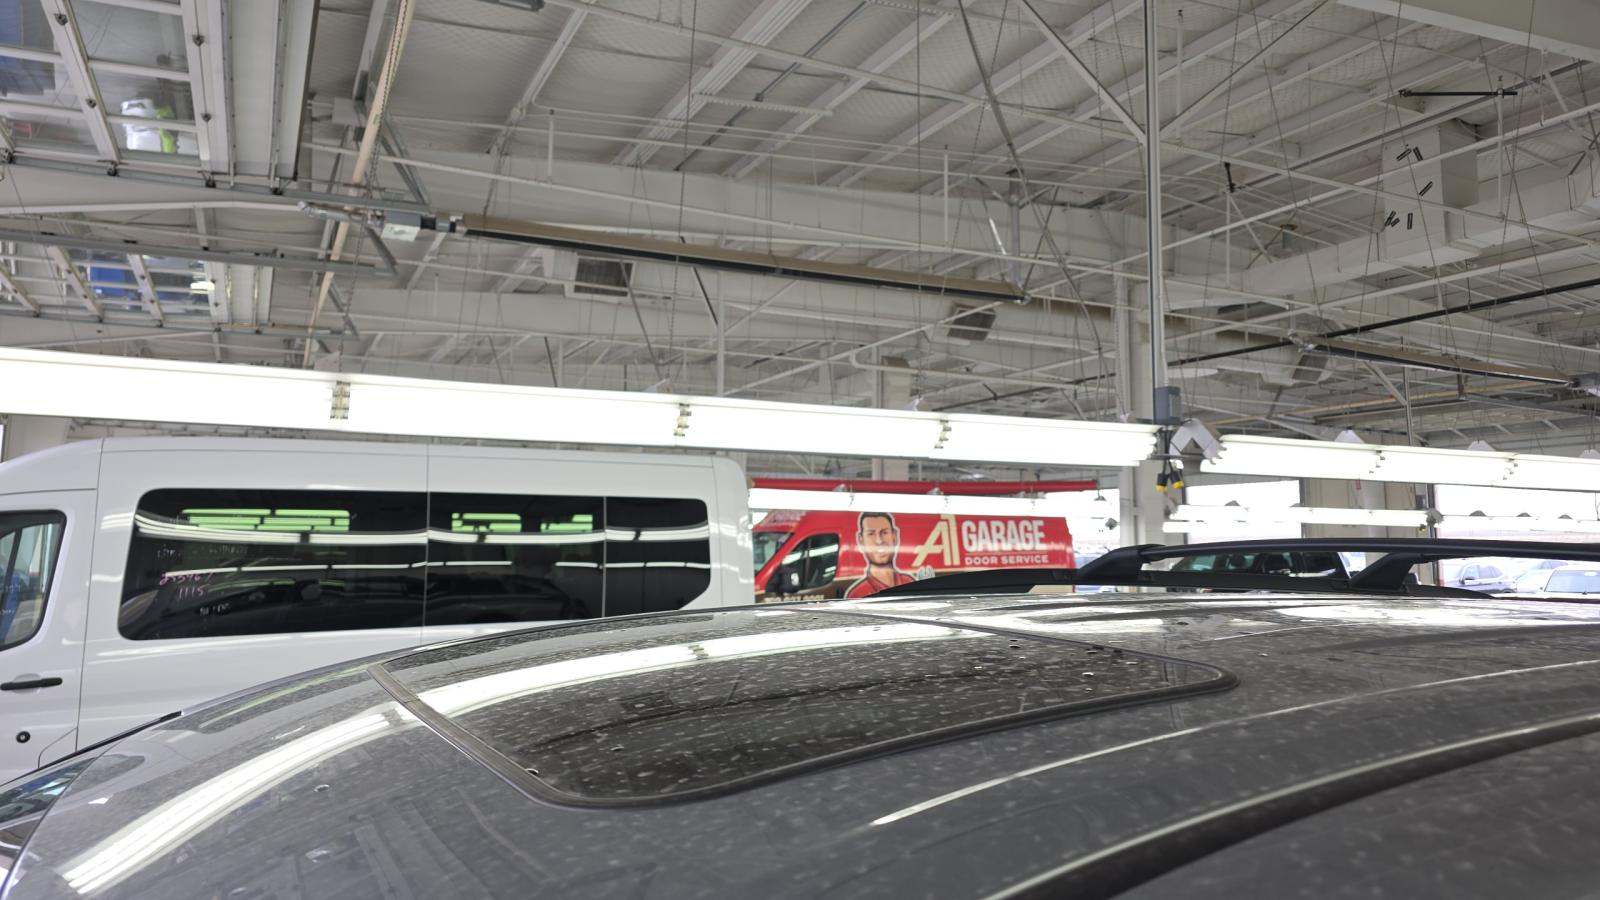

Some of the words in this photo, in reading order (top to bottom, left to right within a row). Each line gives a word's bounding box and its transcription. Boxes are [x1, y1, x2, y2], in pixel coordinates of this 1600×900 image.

[961, 519, 1048, 553] GARAGE
[965, 555, 998, 566] DOOR
[1001, 554, 1049, 564] SERVICE
